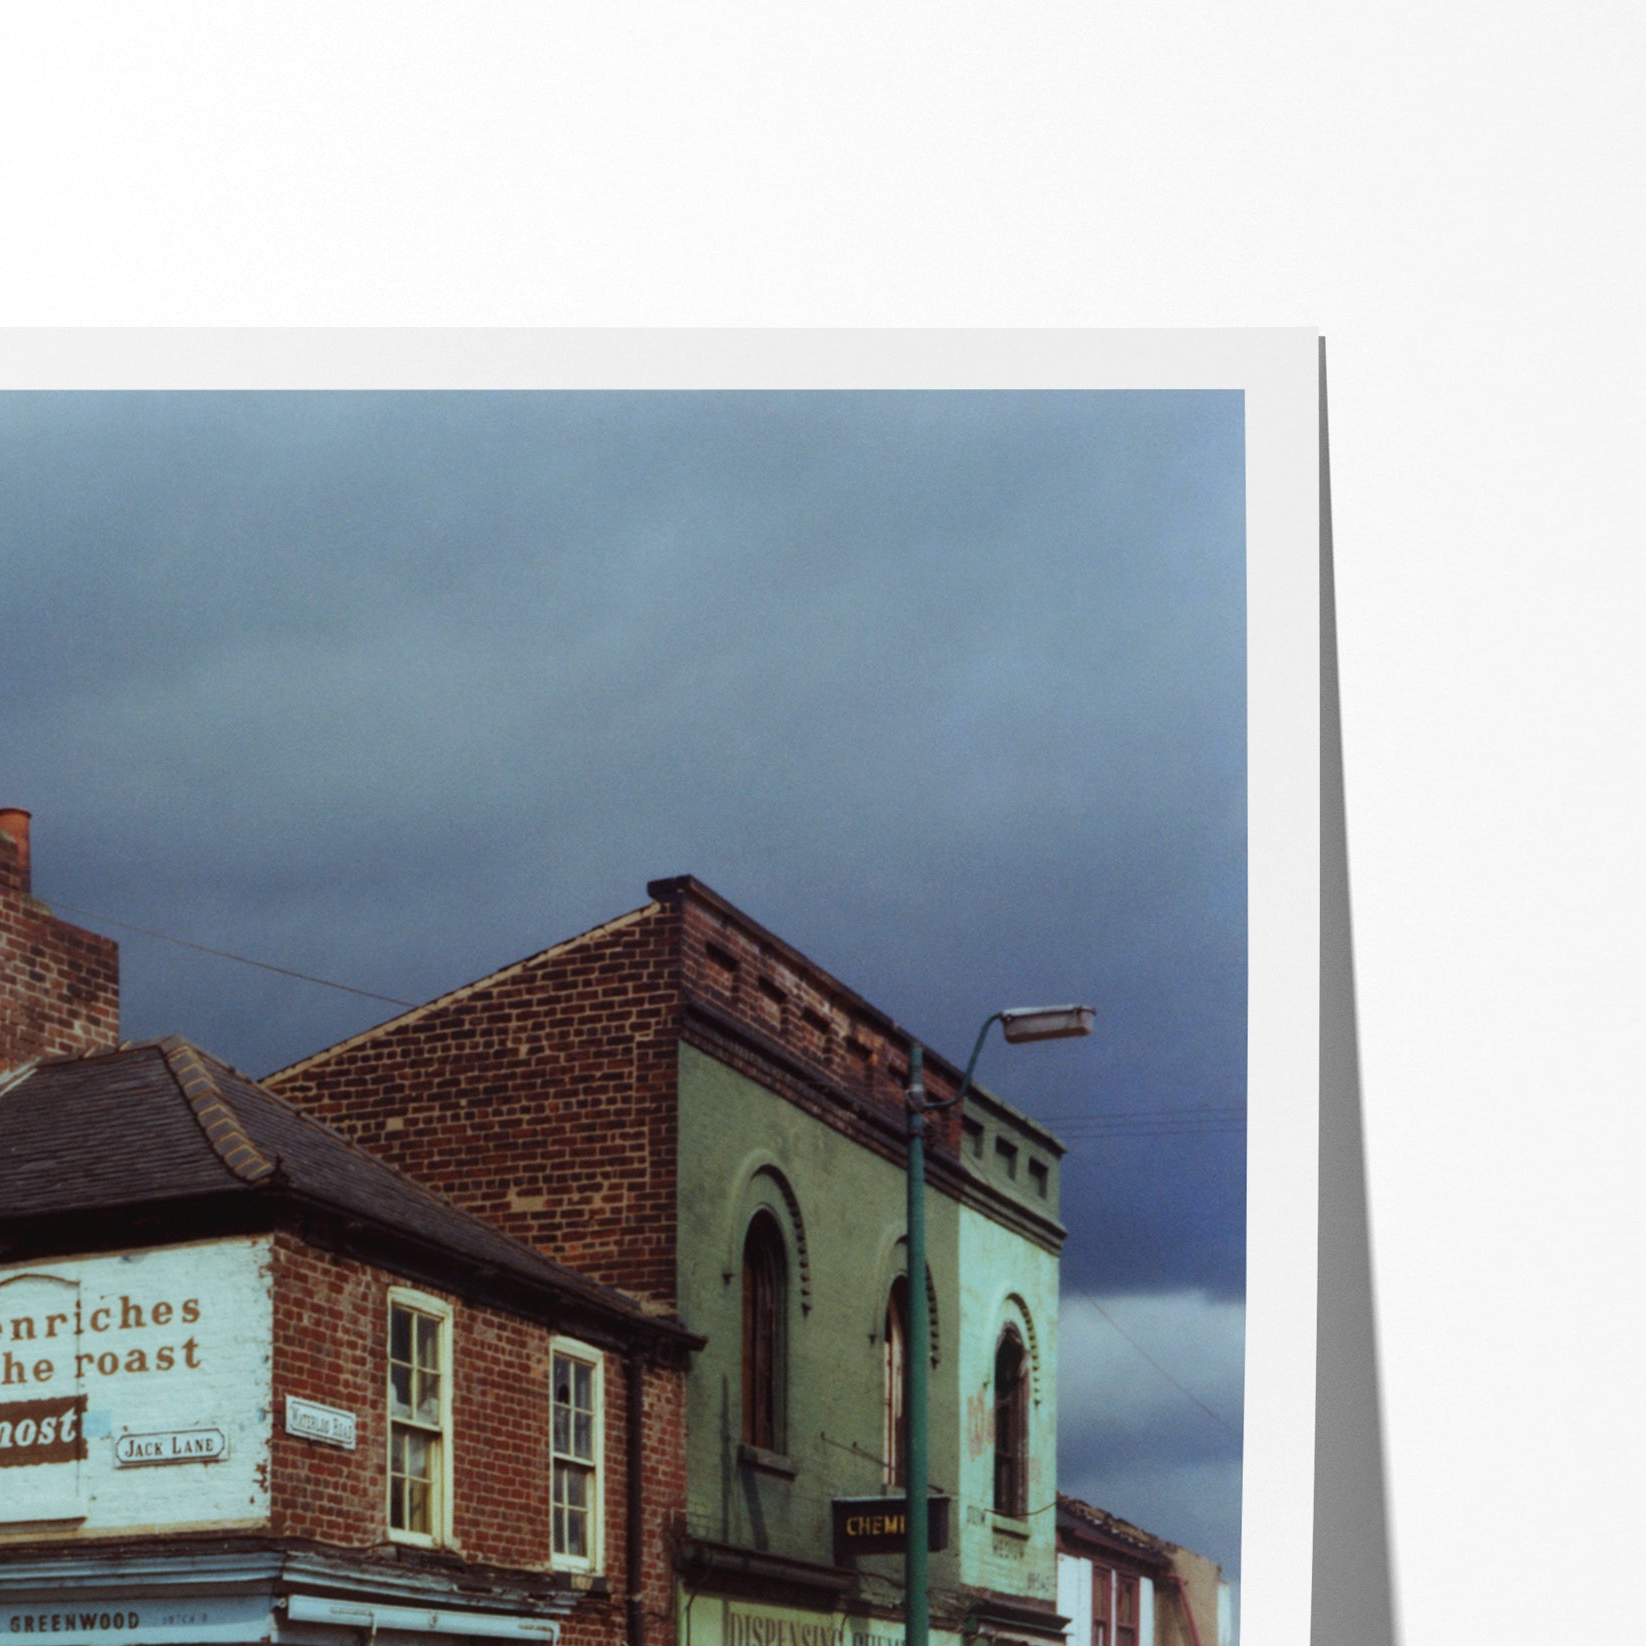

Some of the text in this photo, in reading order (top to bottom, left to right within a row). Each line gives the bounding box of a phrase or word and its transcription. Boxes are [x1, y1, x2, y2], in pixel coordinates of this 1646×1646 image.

[74, 1336, 202, 1380] roast
[125, 1436, 214, 1459] JACK LANE
[846, 1514, 906, 1536] CHEMI
[10, 1611, 140, 1634] GREENWOOD
